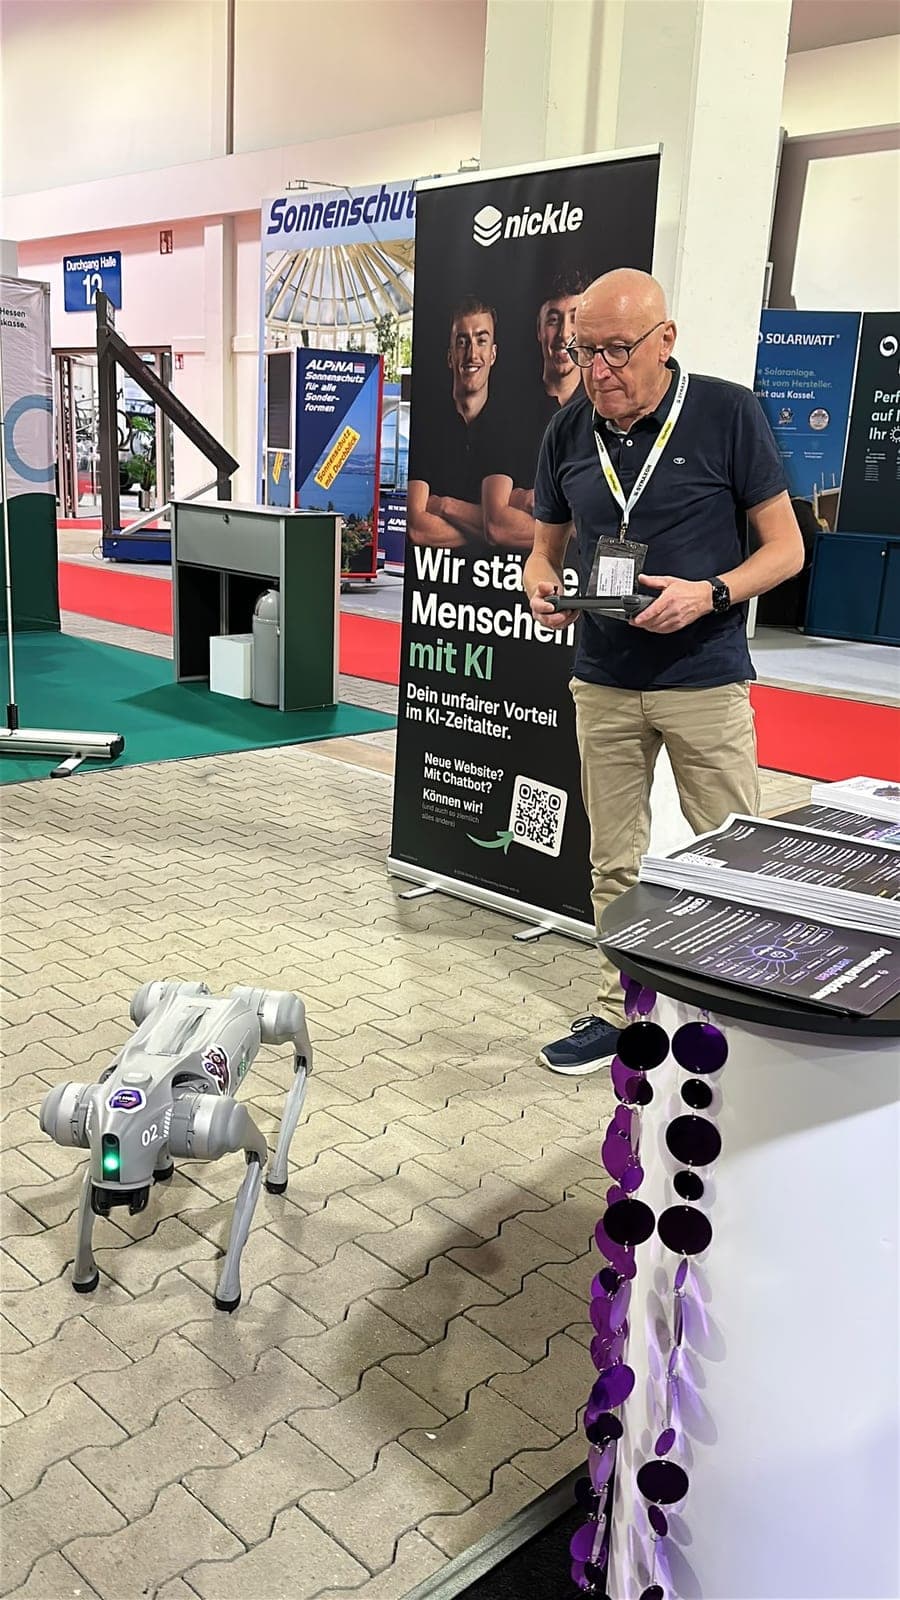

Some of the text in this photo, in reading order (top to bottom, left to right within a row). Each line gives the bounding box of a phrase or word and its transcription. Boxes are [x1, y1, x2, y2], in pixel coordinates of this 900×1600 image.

[267, 184, 416, 234] Sonnenschut
[504, 201, 584, 238] nickle
[66, 256, 116, 272] Durchgang Halle
[82, 273, 104, 304] 12
[305, 372, 365, 383] Sonnenschutz
[764, 367, 816, 378] Solaranlage.
[791, 380, 833, 388] Hersteller.
[305, 382, 337, 392] für alle
[305, 393, 340, 402] Sonder-
[787, 390, 816, 399] Kassel.
[305, 403, 335, 412] formen
[871, 408, 894, 421] auf
[869, 427, 887, 440] Ihr
[414, 546, 466, 584] Wir
[472, 554, 579, 596] stäe
[411, 591, 575, 646] Menschen
[409, 638, 493, 680] mit KI
[407, 682, 558, 727] Dein unfairer Vorteil
[406, 702, 512, 740] im KI-Zeitalter.
[424, 752, 504, 781] Neue Website?
[424, 766, 492, 794] Mit Chatbot?
[423, 788, 483, 814] Können wir!
[142, 1124, 158, 1146] 02
